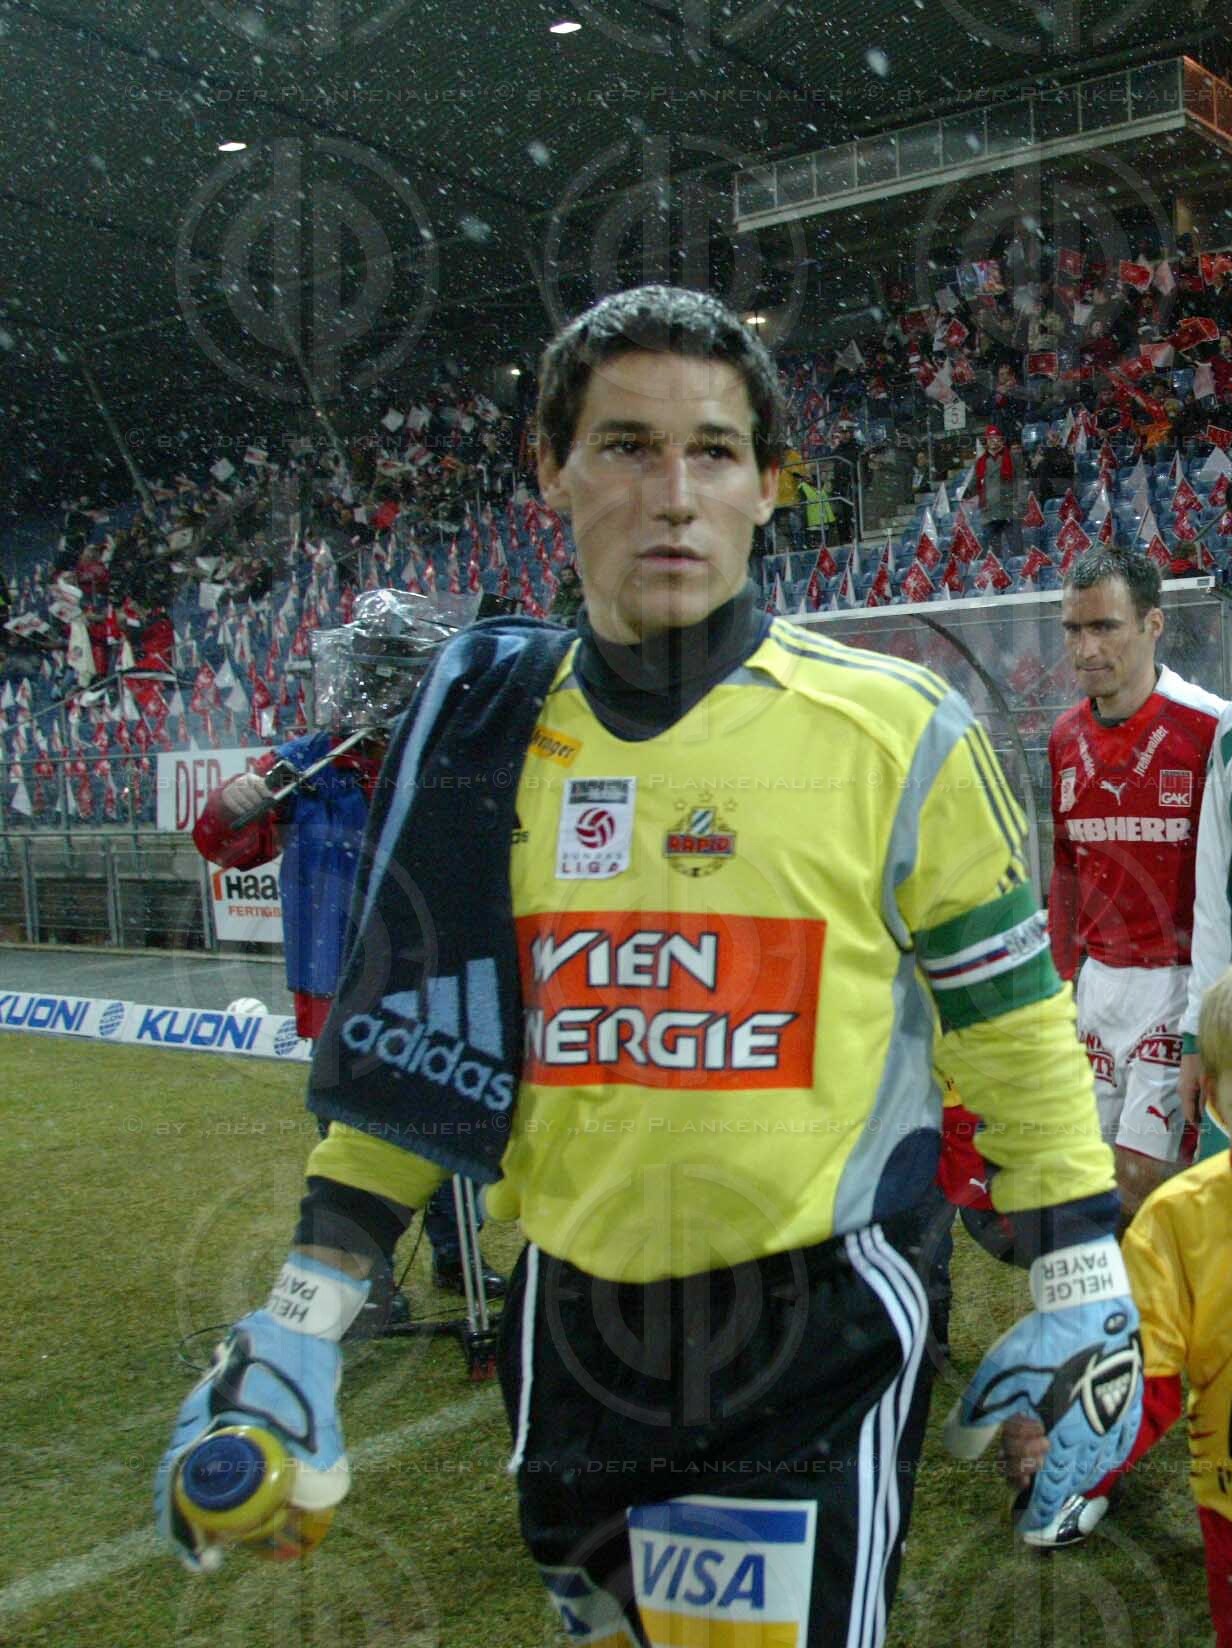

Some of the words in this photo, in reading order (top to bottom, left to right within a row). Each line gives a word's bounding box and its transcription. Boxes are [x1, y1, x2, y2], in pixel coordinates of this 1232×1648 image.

[1161, 792, 1189, 806] GAK
[561, 862, 619, 874] LIGA
[224, 874, 281, 901] Haa
[530, 930, 719, 992] WIEN
[136, 1008, 262, 1050] KUONI
[523, 1006, 800, 1071] NERGIE
[342, 1013, 514, 1111] adidas
[1041, 1253, 1108, 1281] PAYER
[1046, 1271, 1114, 1304] HELGE
[640, 1541, 765, 1610] VISA
